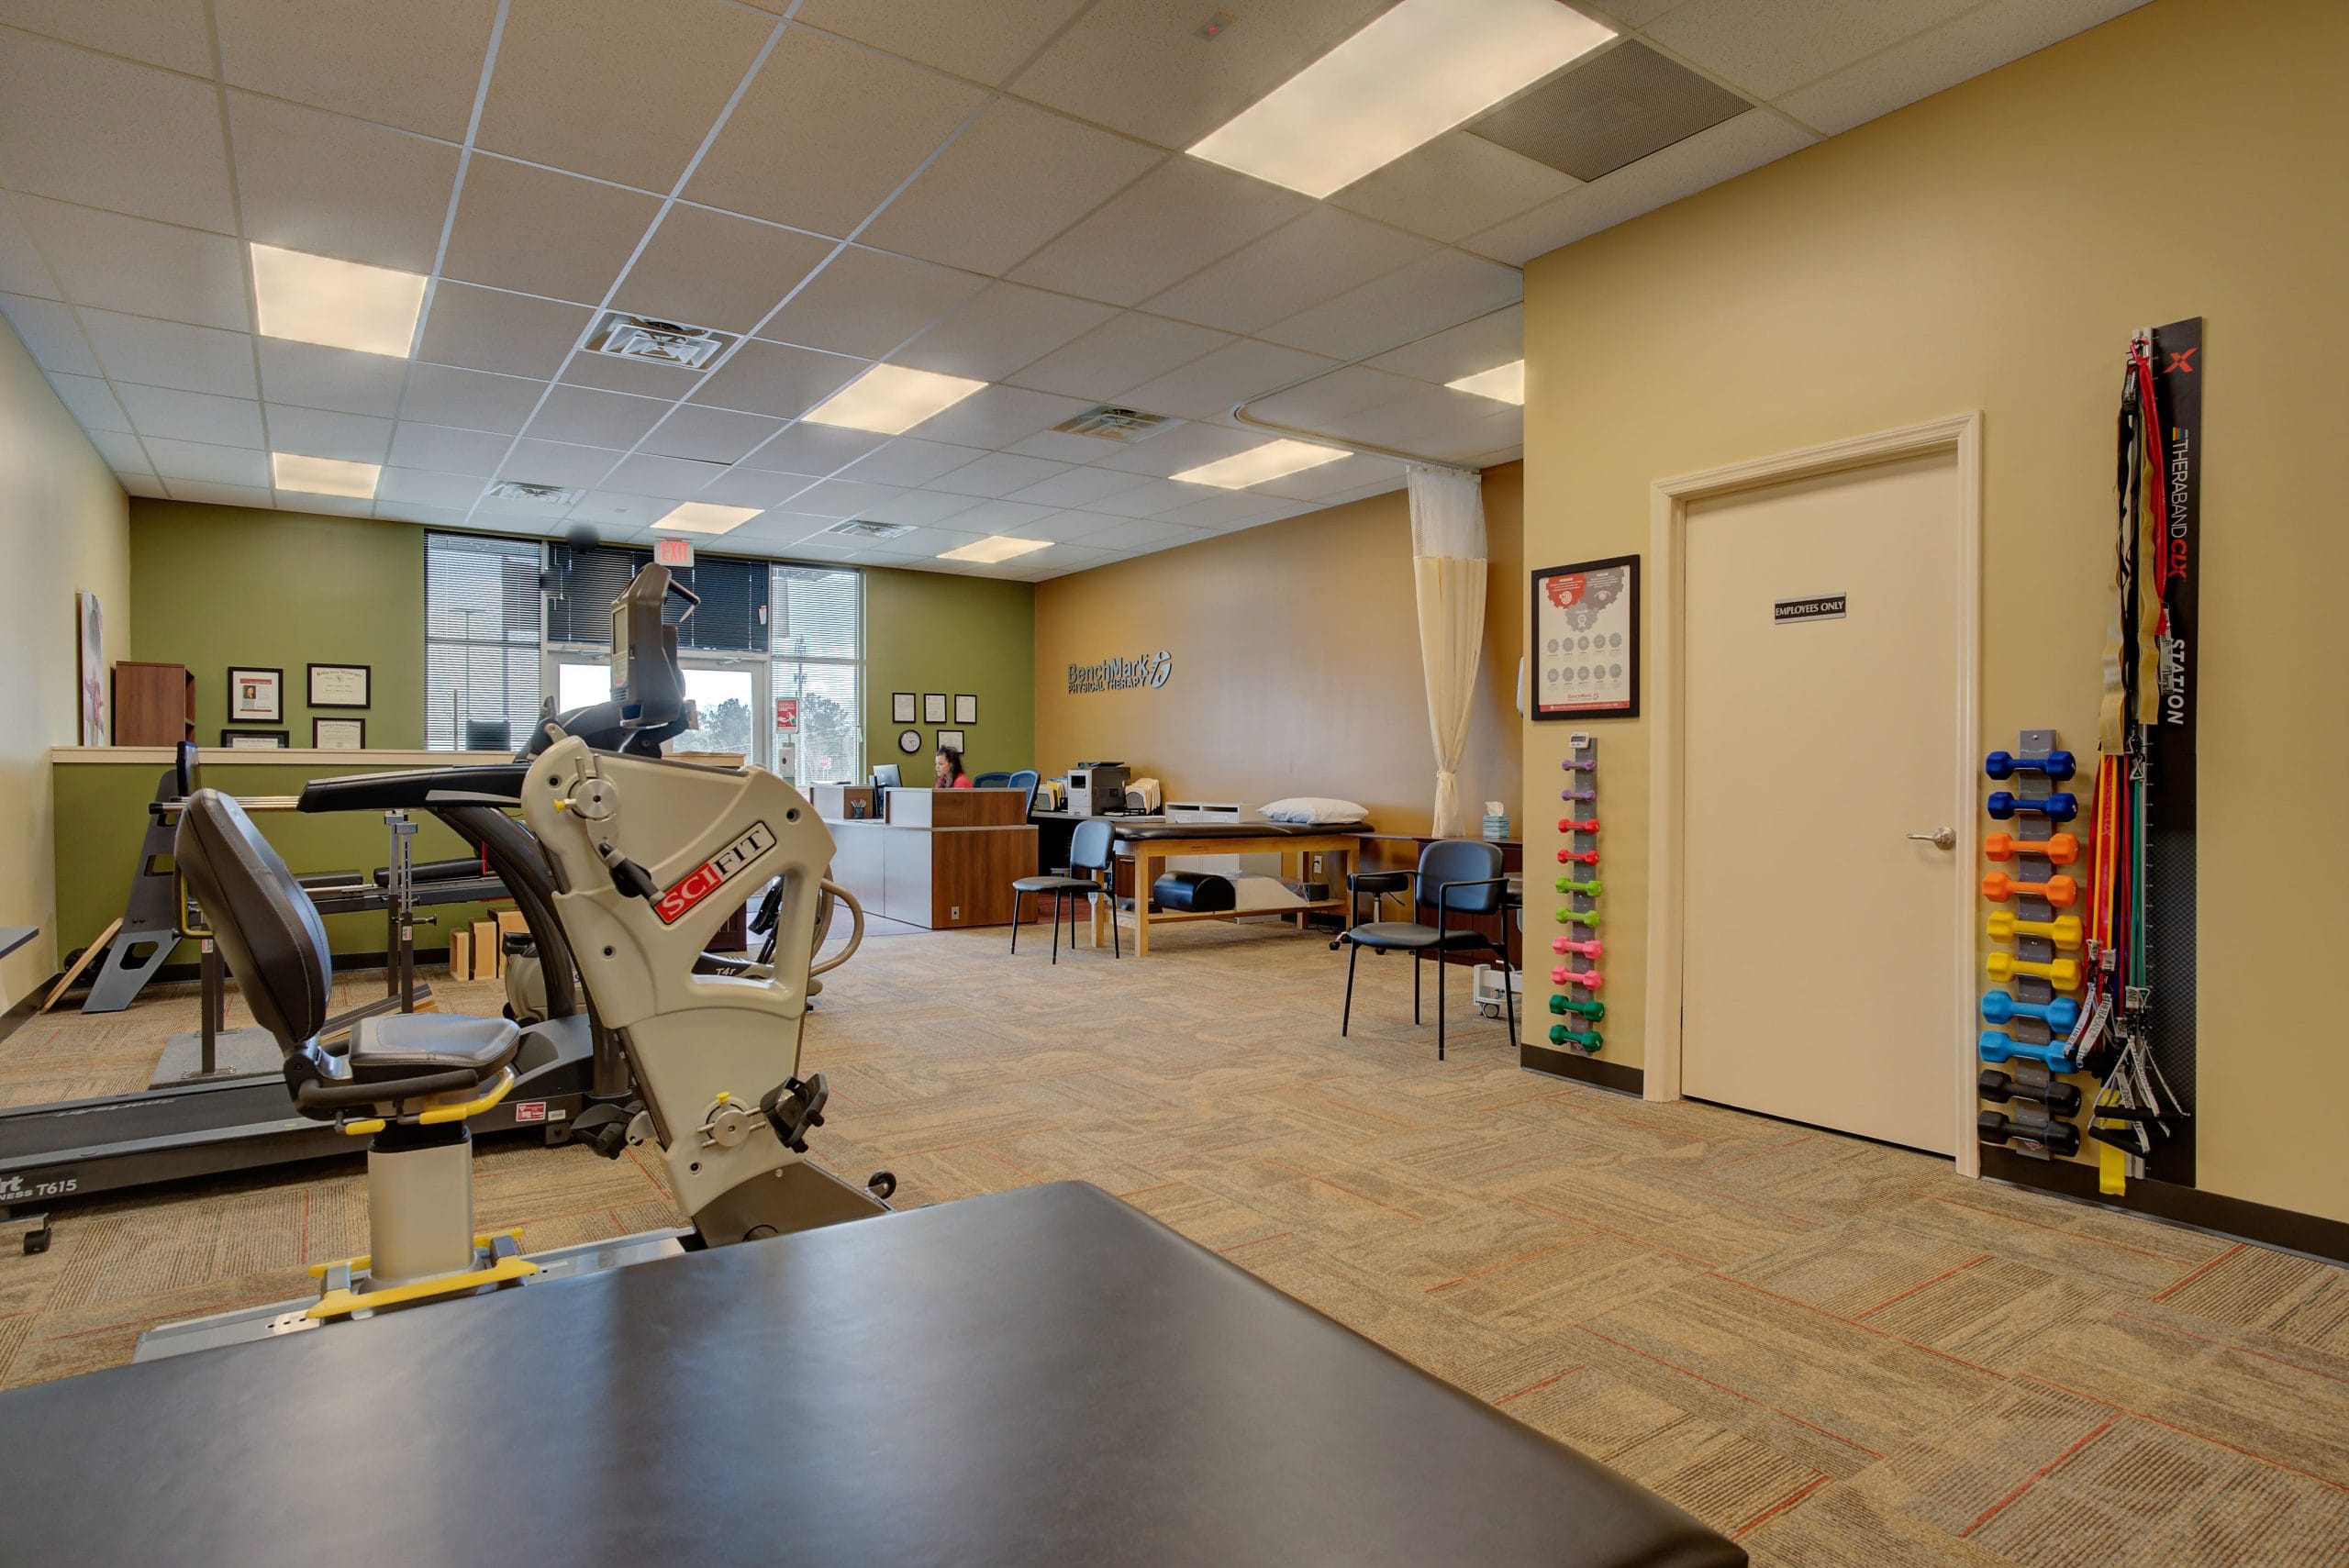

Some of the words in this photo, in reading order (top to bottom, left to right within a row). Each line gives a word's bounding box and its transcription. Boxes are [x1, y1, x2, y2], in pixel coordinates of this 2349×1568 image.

[2171, 439, 2188, 539] THERABAND
[661, 541, 689, 564] EXIT
[2168, 539, 2188, 579] CLX
[1776, 604, 1819, 617] EMPLOYEES
[1820, 601, 1844, 612] ONLY
[1068, 653, 1150, 684] BenchMark
[2167, 639, 2186, 725] STATION
[1068, 680, 1105, 695] PHYSICAL
[1108, 675, 1146, 691] THERAPY
[662, 830, 765, 916] SCIFIT
[37, 1179, 77, 1195] T615
